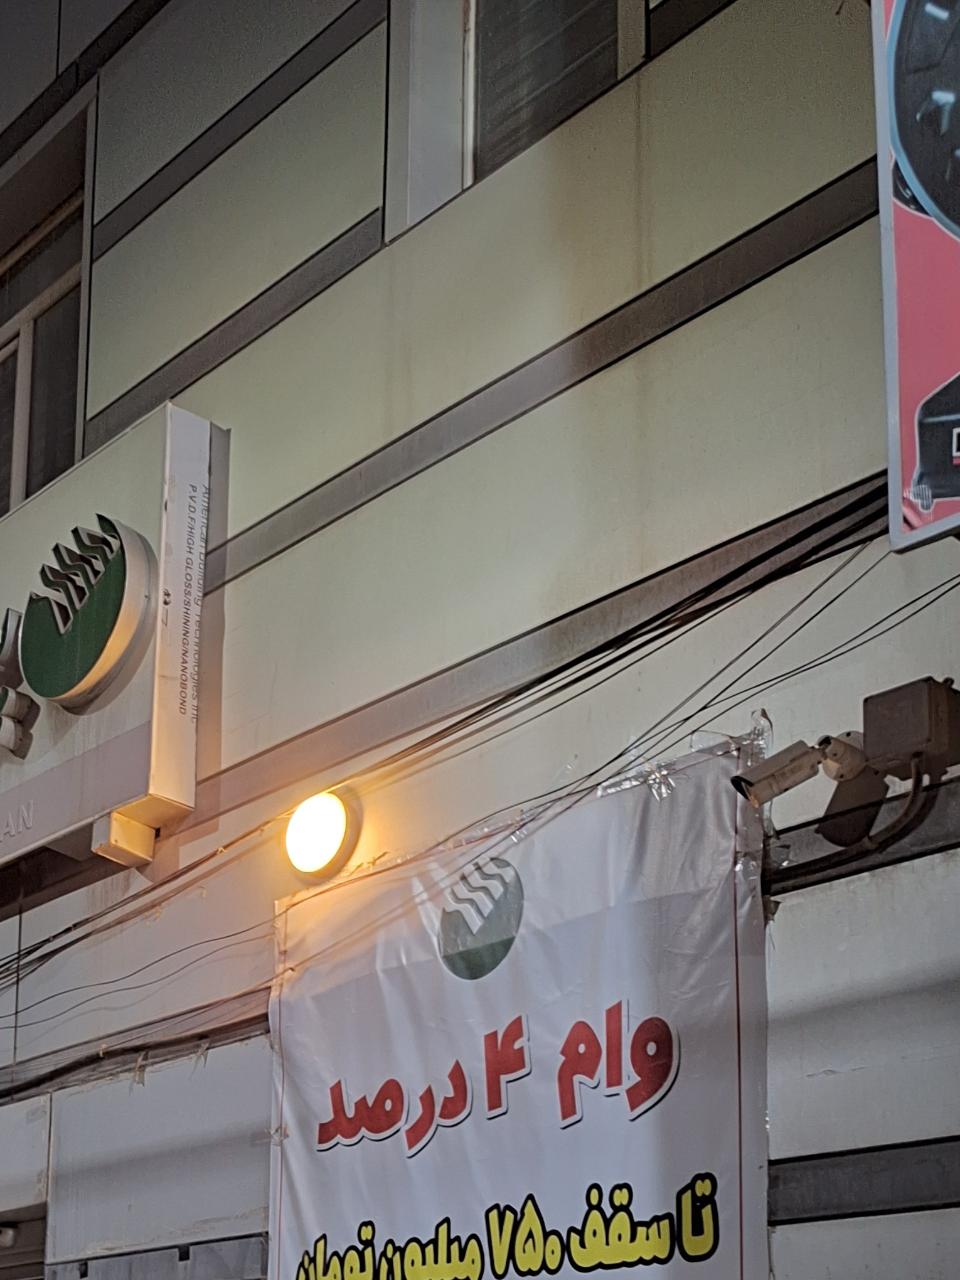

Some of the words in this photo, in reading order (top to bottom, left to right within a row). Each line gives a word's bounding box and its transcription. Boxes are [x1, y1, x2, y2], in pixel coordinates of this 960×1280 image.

[316, 1059, 471, 1156] درصد
[483, 1014, 530, 1116] ۴
[557, 1000, 678, 1125] وام
[567, 1182, 675, 1271] سقف
[677, 1172, 718, 1262] تا
